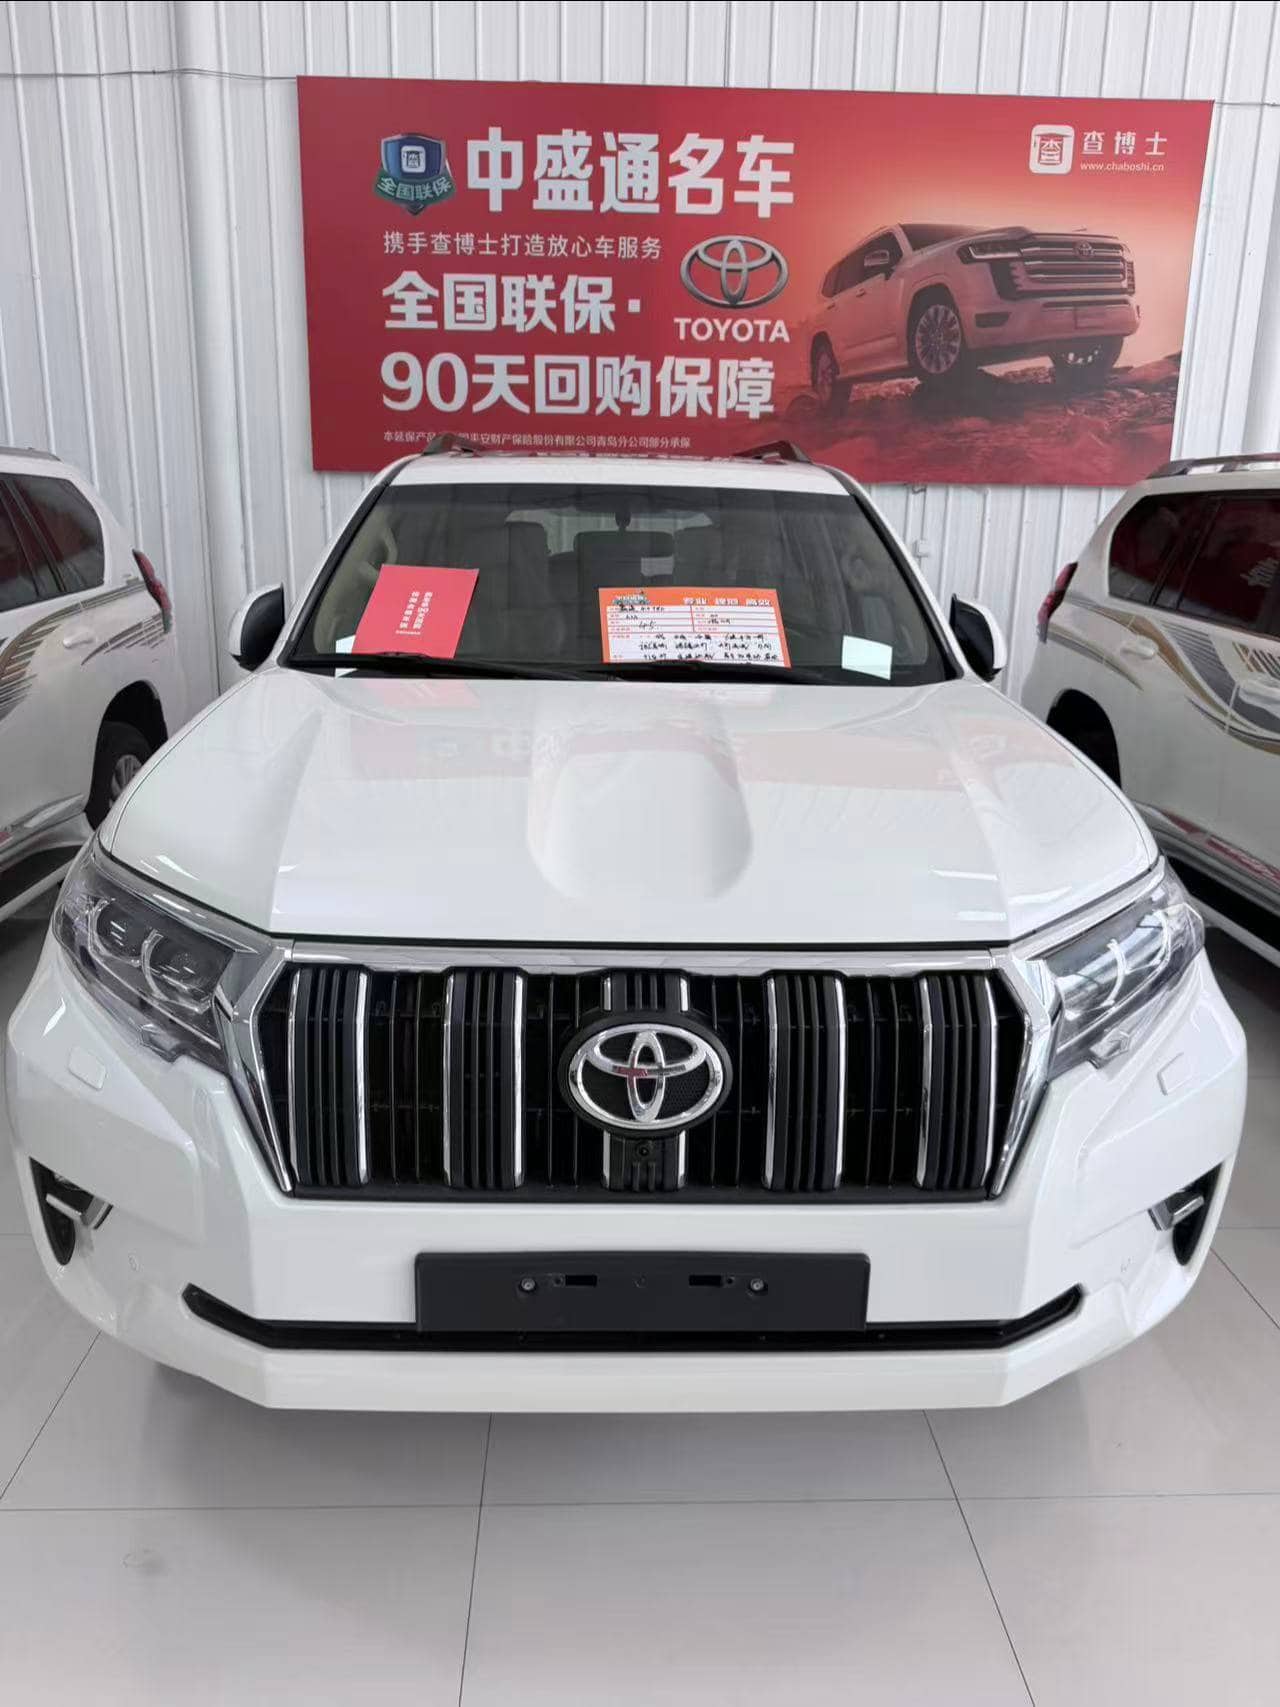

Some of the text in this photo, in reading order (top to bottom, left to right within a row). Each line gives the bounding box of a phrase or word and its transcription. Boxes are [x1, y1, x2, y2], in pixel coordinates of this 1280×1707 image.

[1080, 130, 1168, 156] 查博士
[466, 126, 795, 219] 中盛通名车
[1080, 160, 1166, 172] www.chaboshi.cn
[376, 176, 452, 201] 全国联保
[383, 230, 663, 260] 携手查博士打造放心车服务
[673, 316, 791, 343] TOYOTA
[379, 350, 776, 420] 90天回购保障
